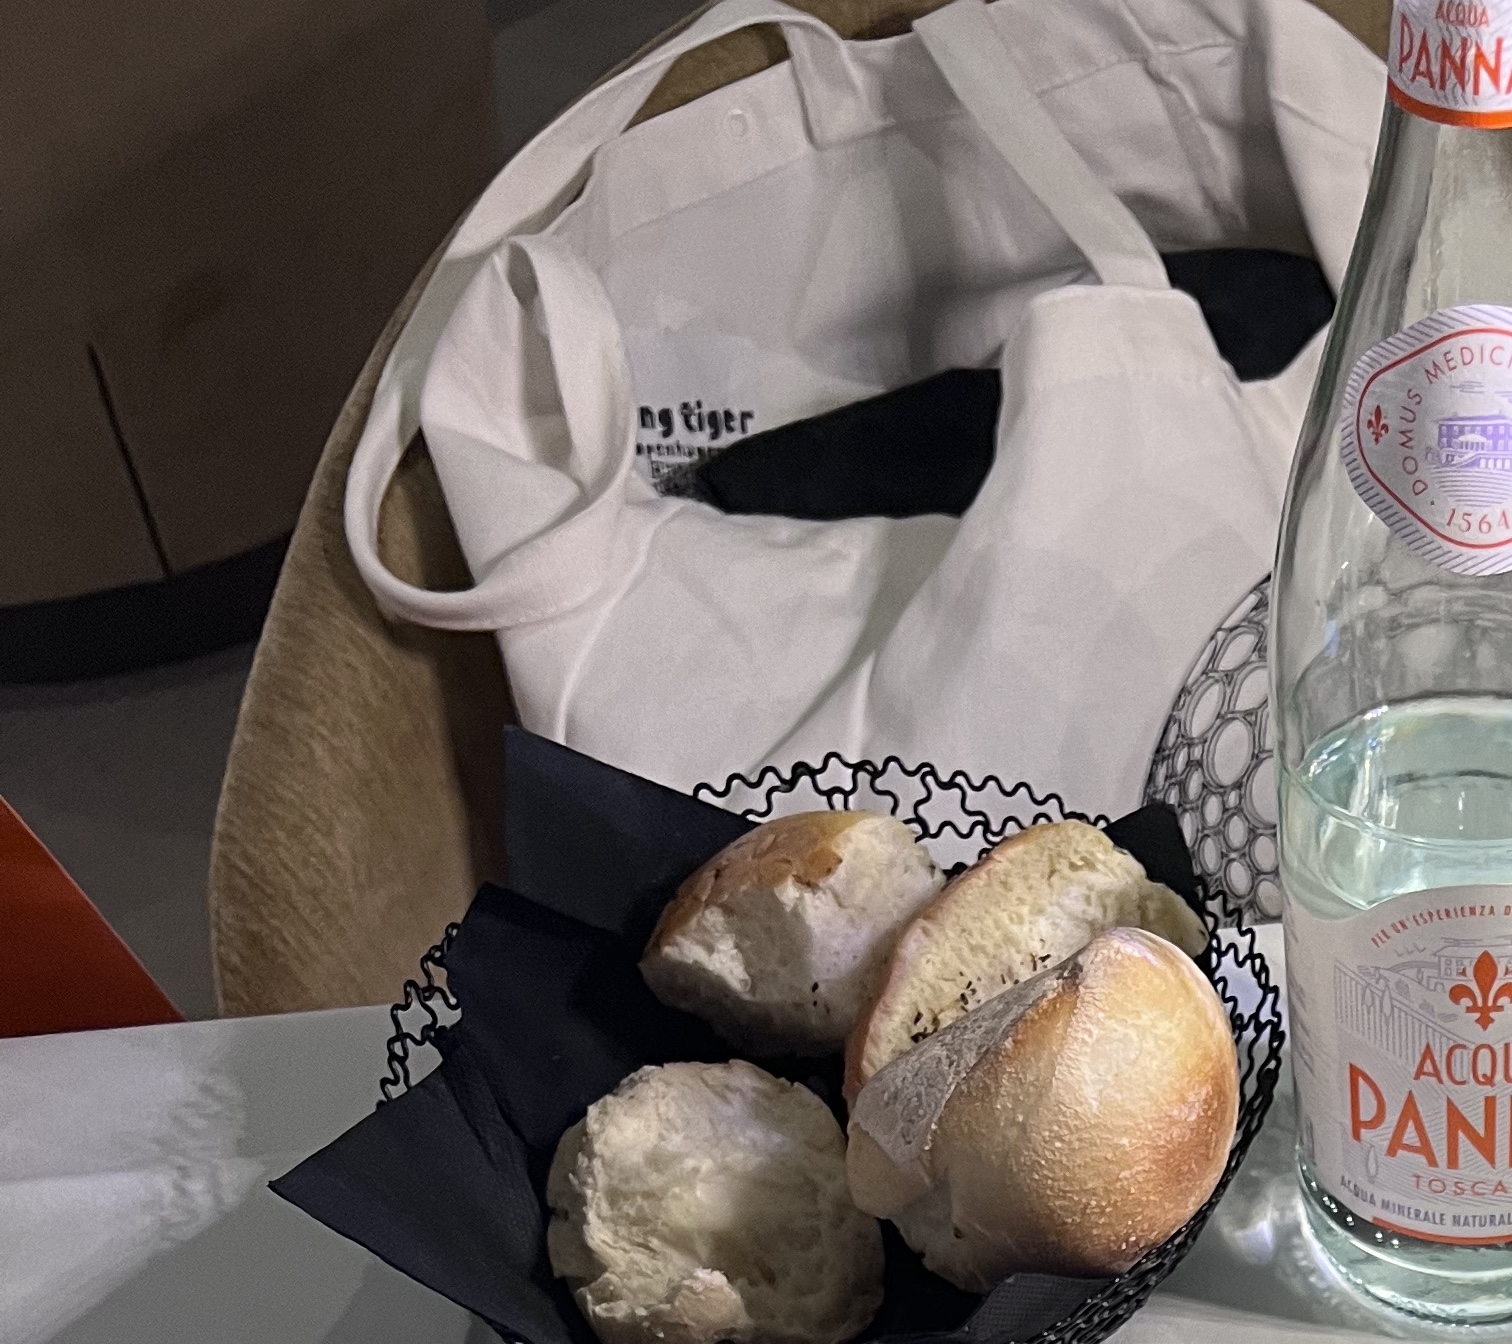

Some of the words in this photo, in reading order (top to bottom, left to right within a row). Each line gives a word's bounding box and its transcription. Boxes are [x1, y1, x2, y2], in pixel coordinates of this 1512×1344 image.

[1435, 0, 1489, 28] ACQUA
[680, 399, 755, 440] tiger
[1398, 389, 1428, 496] DOMUS
[1340, 1174, 1377, 1207] ACQUA
[1380, 1198, 1446, 1226] MINERALE
